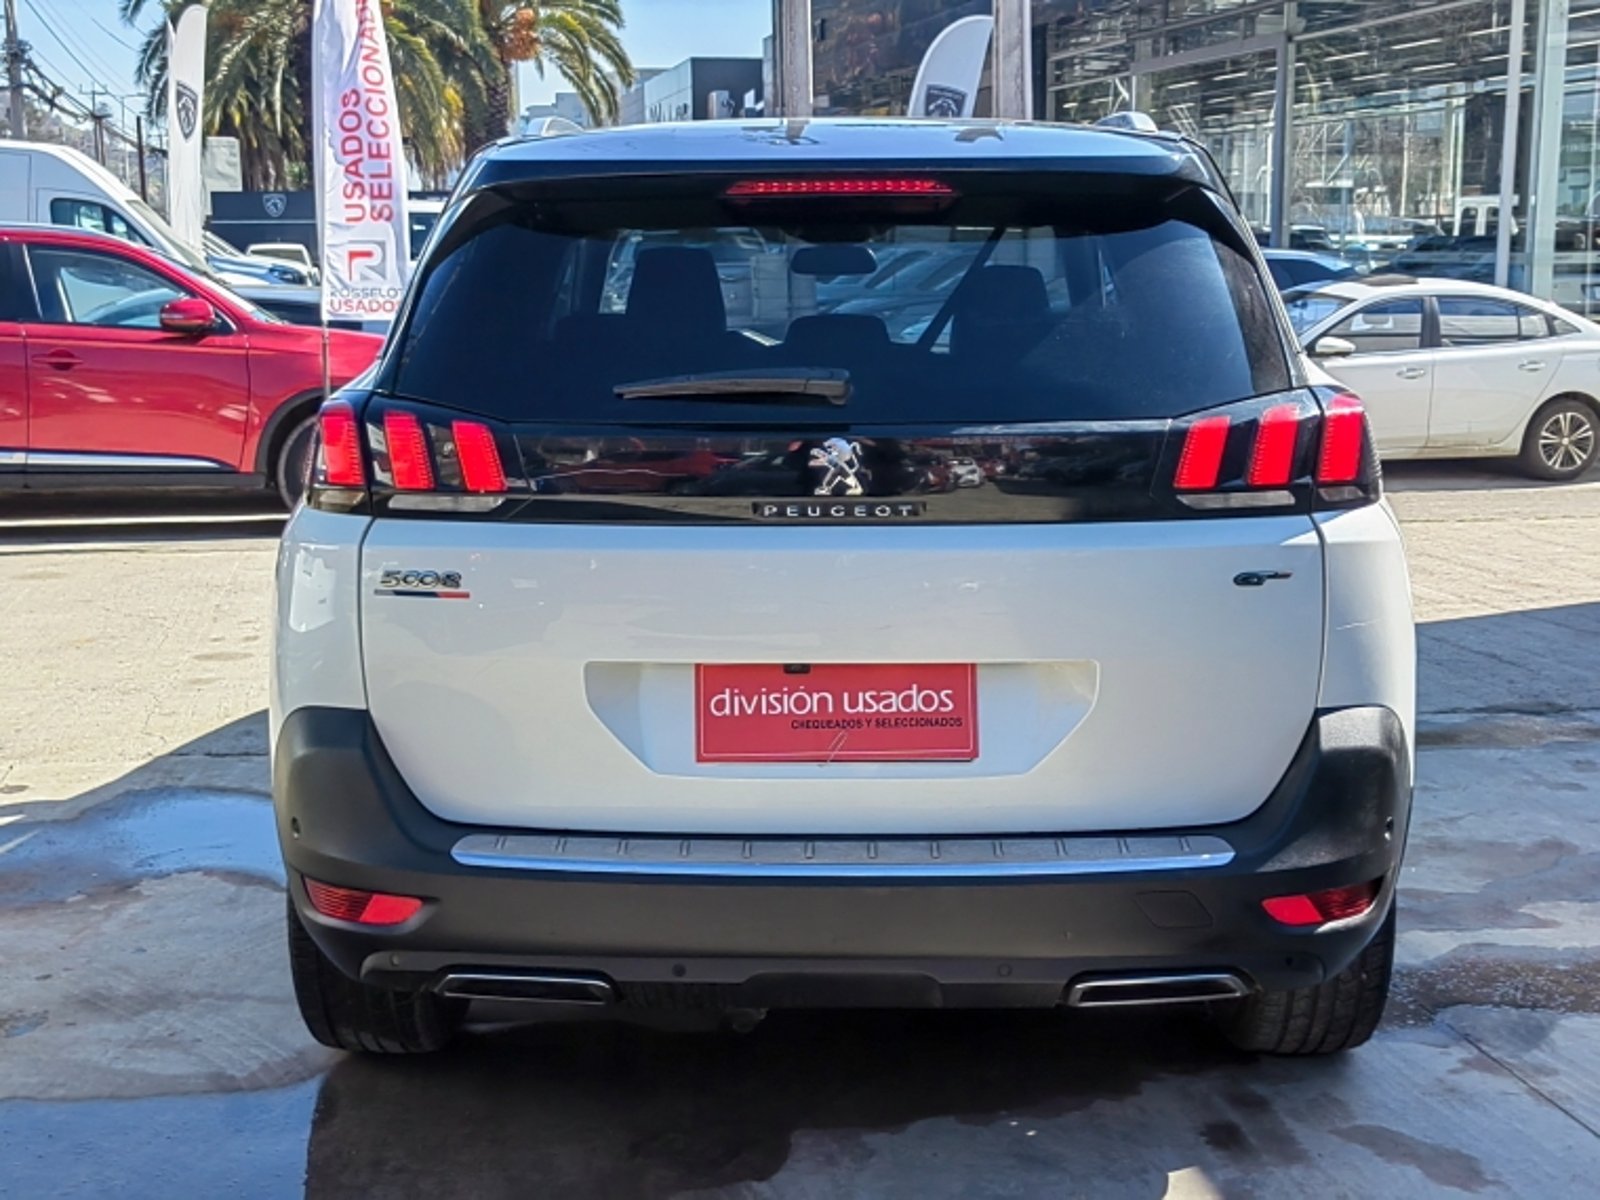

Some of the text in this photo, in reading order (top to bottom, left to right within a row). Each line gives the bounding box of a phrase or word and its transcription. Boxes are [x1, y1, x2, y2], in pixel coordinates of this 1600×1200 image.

[356, 0, 394, 222] SELECCIONAD
[339, 88, 366, 222] USADOS
[330, 299, 401, 313] USADO
[763, 504, 913, 517] PEUGEOT
[380, 570, 462, 588] 5008
[709, 684, 955, 716] división usados
[791, 717, 963, 729] CHEQUEADOS Y SELECCIONADOS
